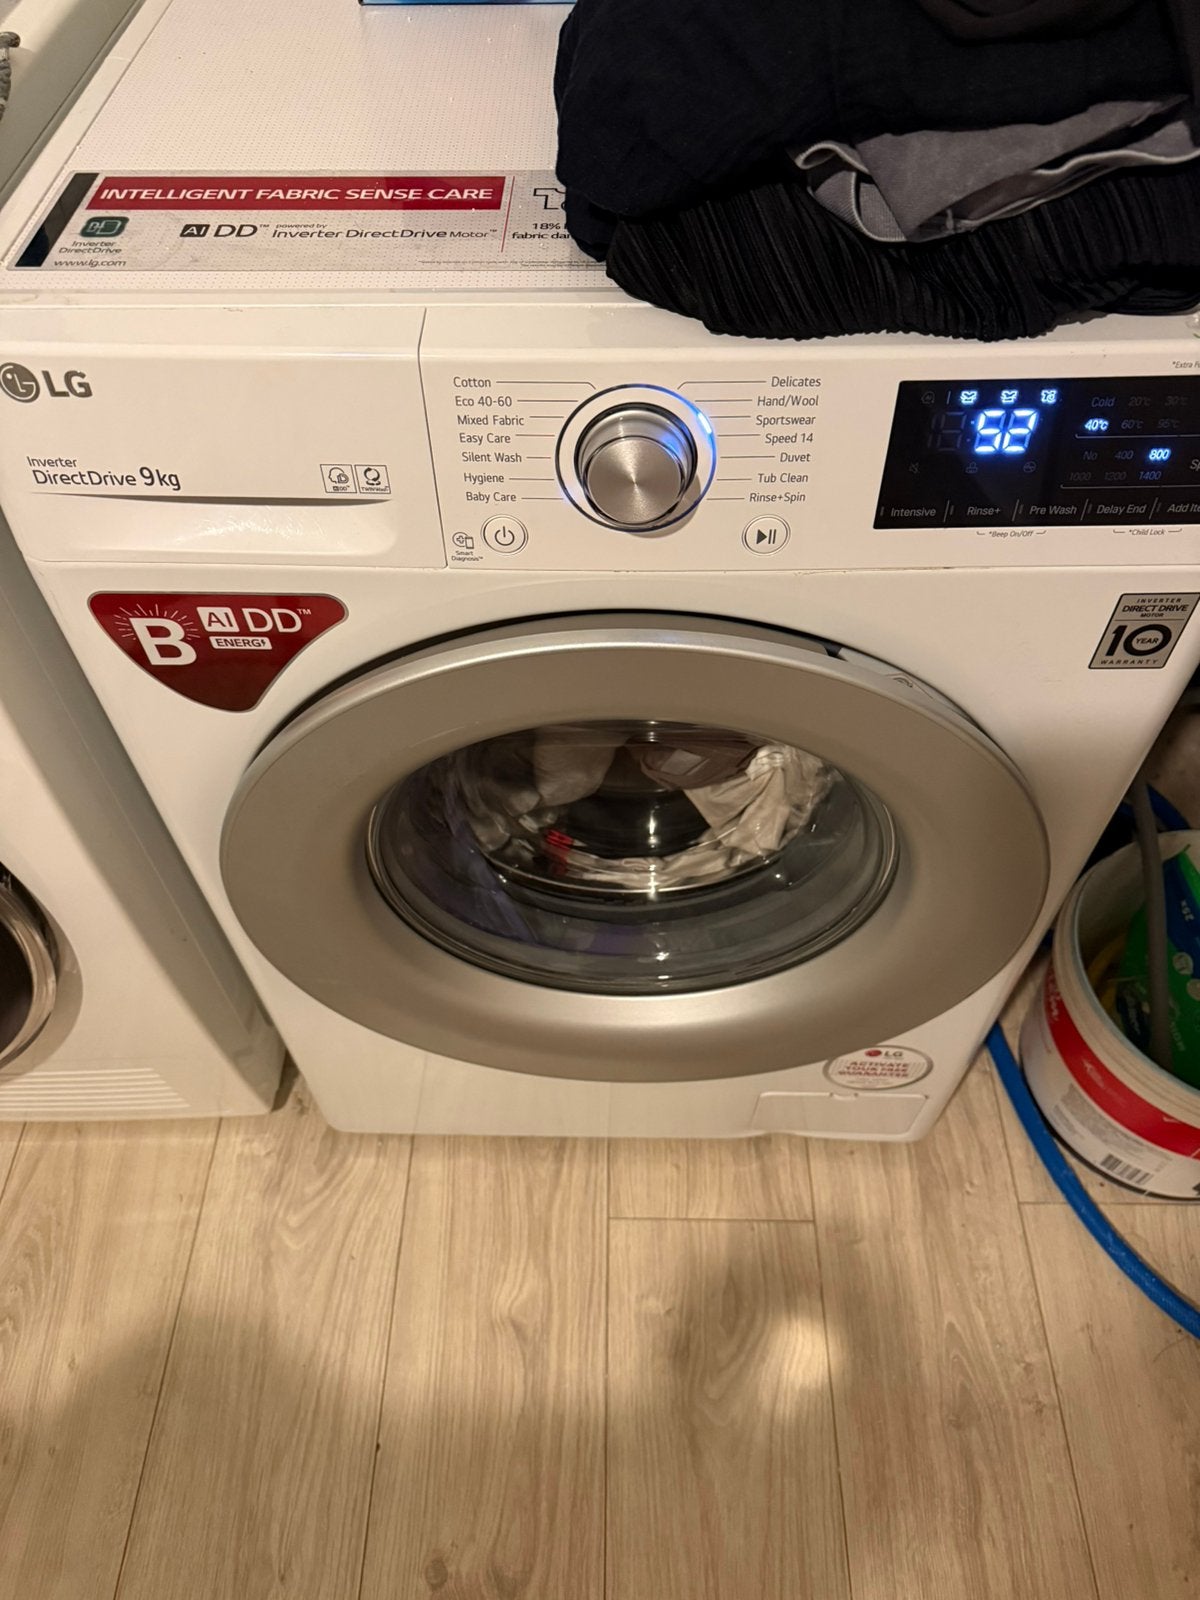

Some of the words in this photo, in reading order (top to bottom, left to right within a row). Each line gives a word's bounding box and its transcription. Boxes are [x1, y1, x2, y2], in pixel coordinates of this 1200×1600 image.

[101, 189, 252, 200] INTELLIGENT
[256, 189, 341, 200] FABRIC
[345, 189, 424, 200] SENSE
[427, 189, 494, 200] CARE
[181, 225, 209, 236] AI
[272, 230, 343, 238] Inverter
[346, 230, 447, 238] DirectDrive
[42, 370, 93, 398] LG
[454, 377, 491, 388] Cotton
[771, 376, 821, 387] Delicates
[455, 396, 474, 406] Eco
[478, 396, 512, 407] 40-60
[758, 394, 819, 407] Hand/Wool
[1091, 397, 1115, 407] Cold
[457, 415, 488, 425] Mixed
[493, 415, 524, 425] Fabric
[756, 415, 816, 428] Sportswear
[1084, 419, 1109, 431] 40°C
[459, 433, 483, 445] Easy
[487, 433, 511, 443] Care
[765, 433, 798, 445] Speed
[801, 433, 813, 443] 14
[462, 452, 492, 462] Silent
[494, 453, 522, 462] Wash
[780, 452, 811, 462] Duvet
[1083, 451, 1097, 460] No
[1115, 450, 1134, 460] 400
[1149, 448, 1171, 461] 800
[27, 456, 77, 468] Inverter
[32, 470, 136, 486] DirectDrive
[139, 466, 181, 491] 9kg
[464, 473, 504, 485] Hygiene
[758, 473, 776, 483] Tub
[780, 473, 808, 483] Clean
[1138, 471, 1161, 480] 1400
[466, 492, 490, 503] Baby
[493, 492, 516, 501] Care
[749, 492, 806, 504] Rinse+Spin
[891, 508, 936, 517] Intensive
[967, 506, 1000, 516] Rinse+
[1030, 505, 1046, 514] Pre
[1049, 505, 1077, 514] Wash
[1097, 505, 1125, 515] Delay
[1126, 504, 1147, 514] End
[1167, 504, 1189, 512] Add
[1010, 530, 1034, 538] On/Off
[1122, 604, 1157, 612] DIRECT
[1158, 604, 1189, 612] DRIVE
[202, 609, 237, 630] AI
[129, 617, 197, 666] B
[1105, 624, 1172, 657] 10
